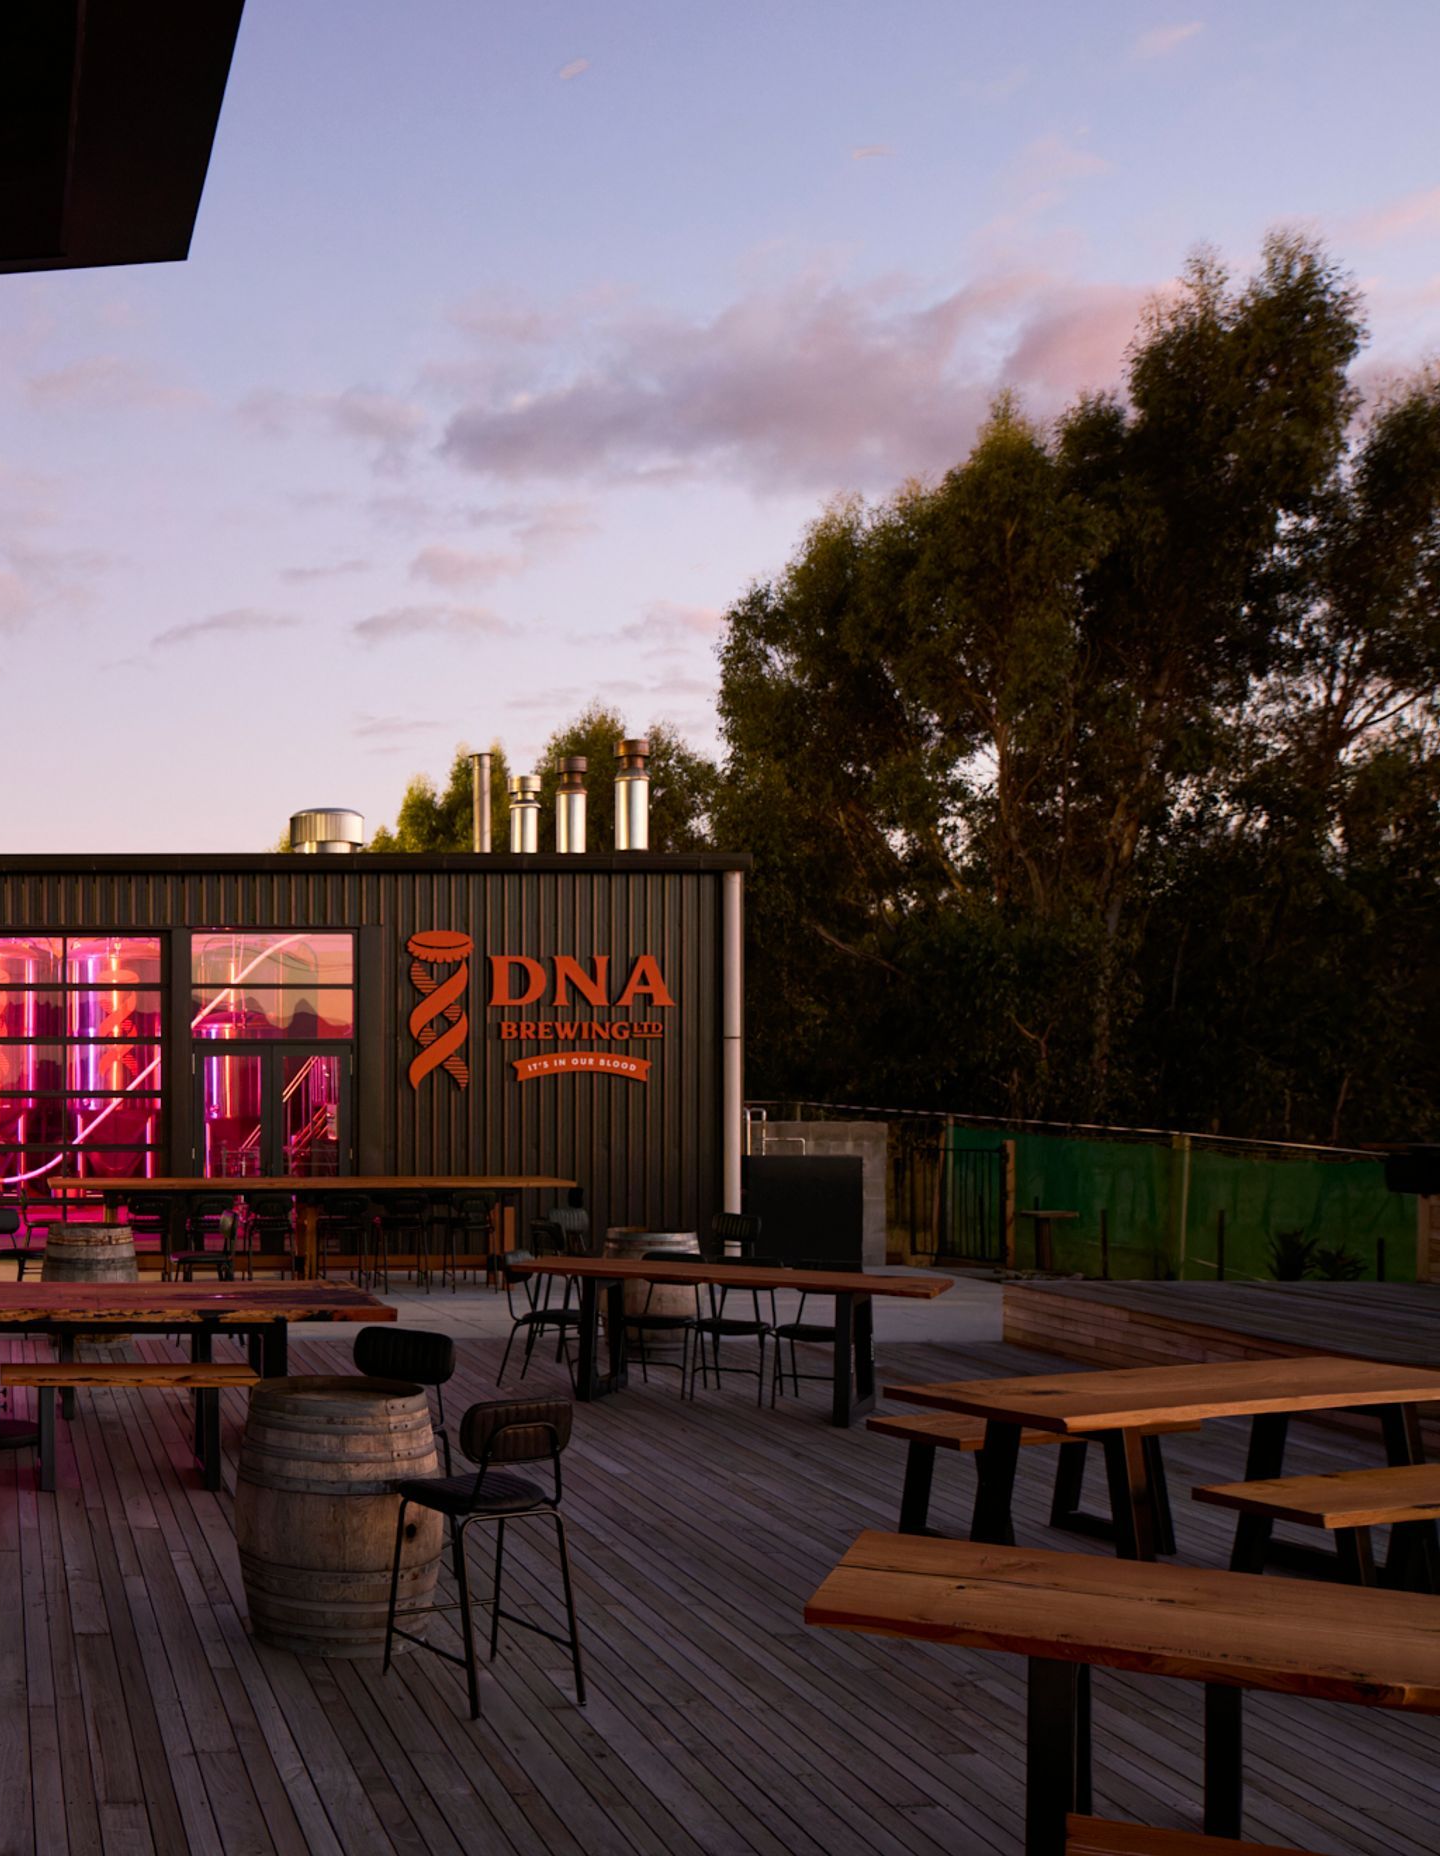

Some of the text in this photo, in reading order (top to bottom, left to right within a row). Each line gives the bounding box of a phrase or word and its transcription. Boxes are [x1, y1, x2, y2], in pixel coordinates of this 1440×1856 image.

[489, 954, 675, 1007] DNA
[501, 1020, 663, 1041] BREWING LTD
[527, 1057, 637, 1072] IT'S IN OUR BLOOD
